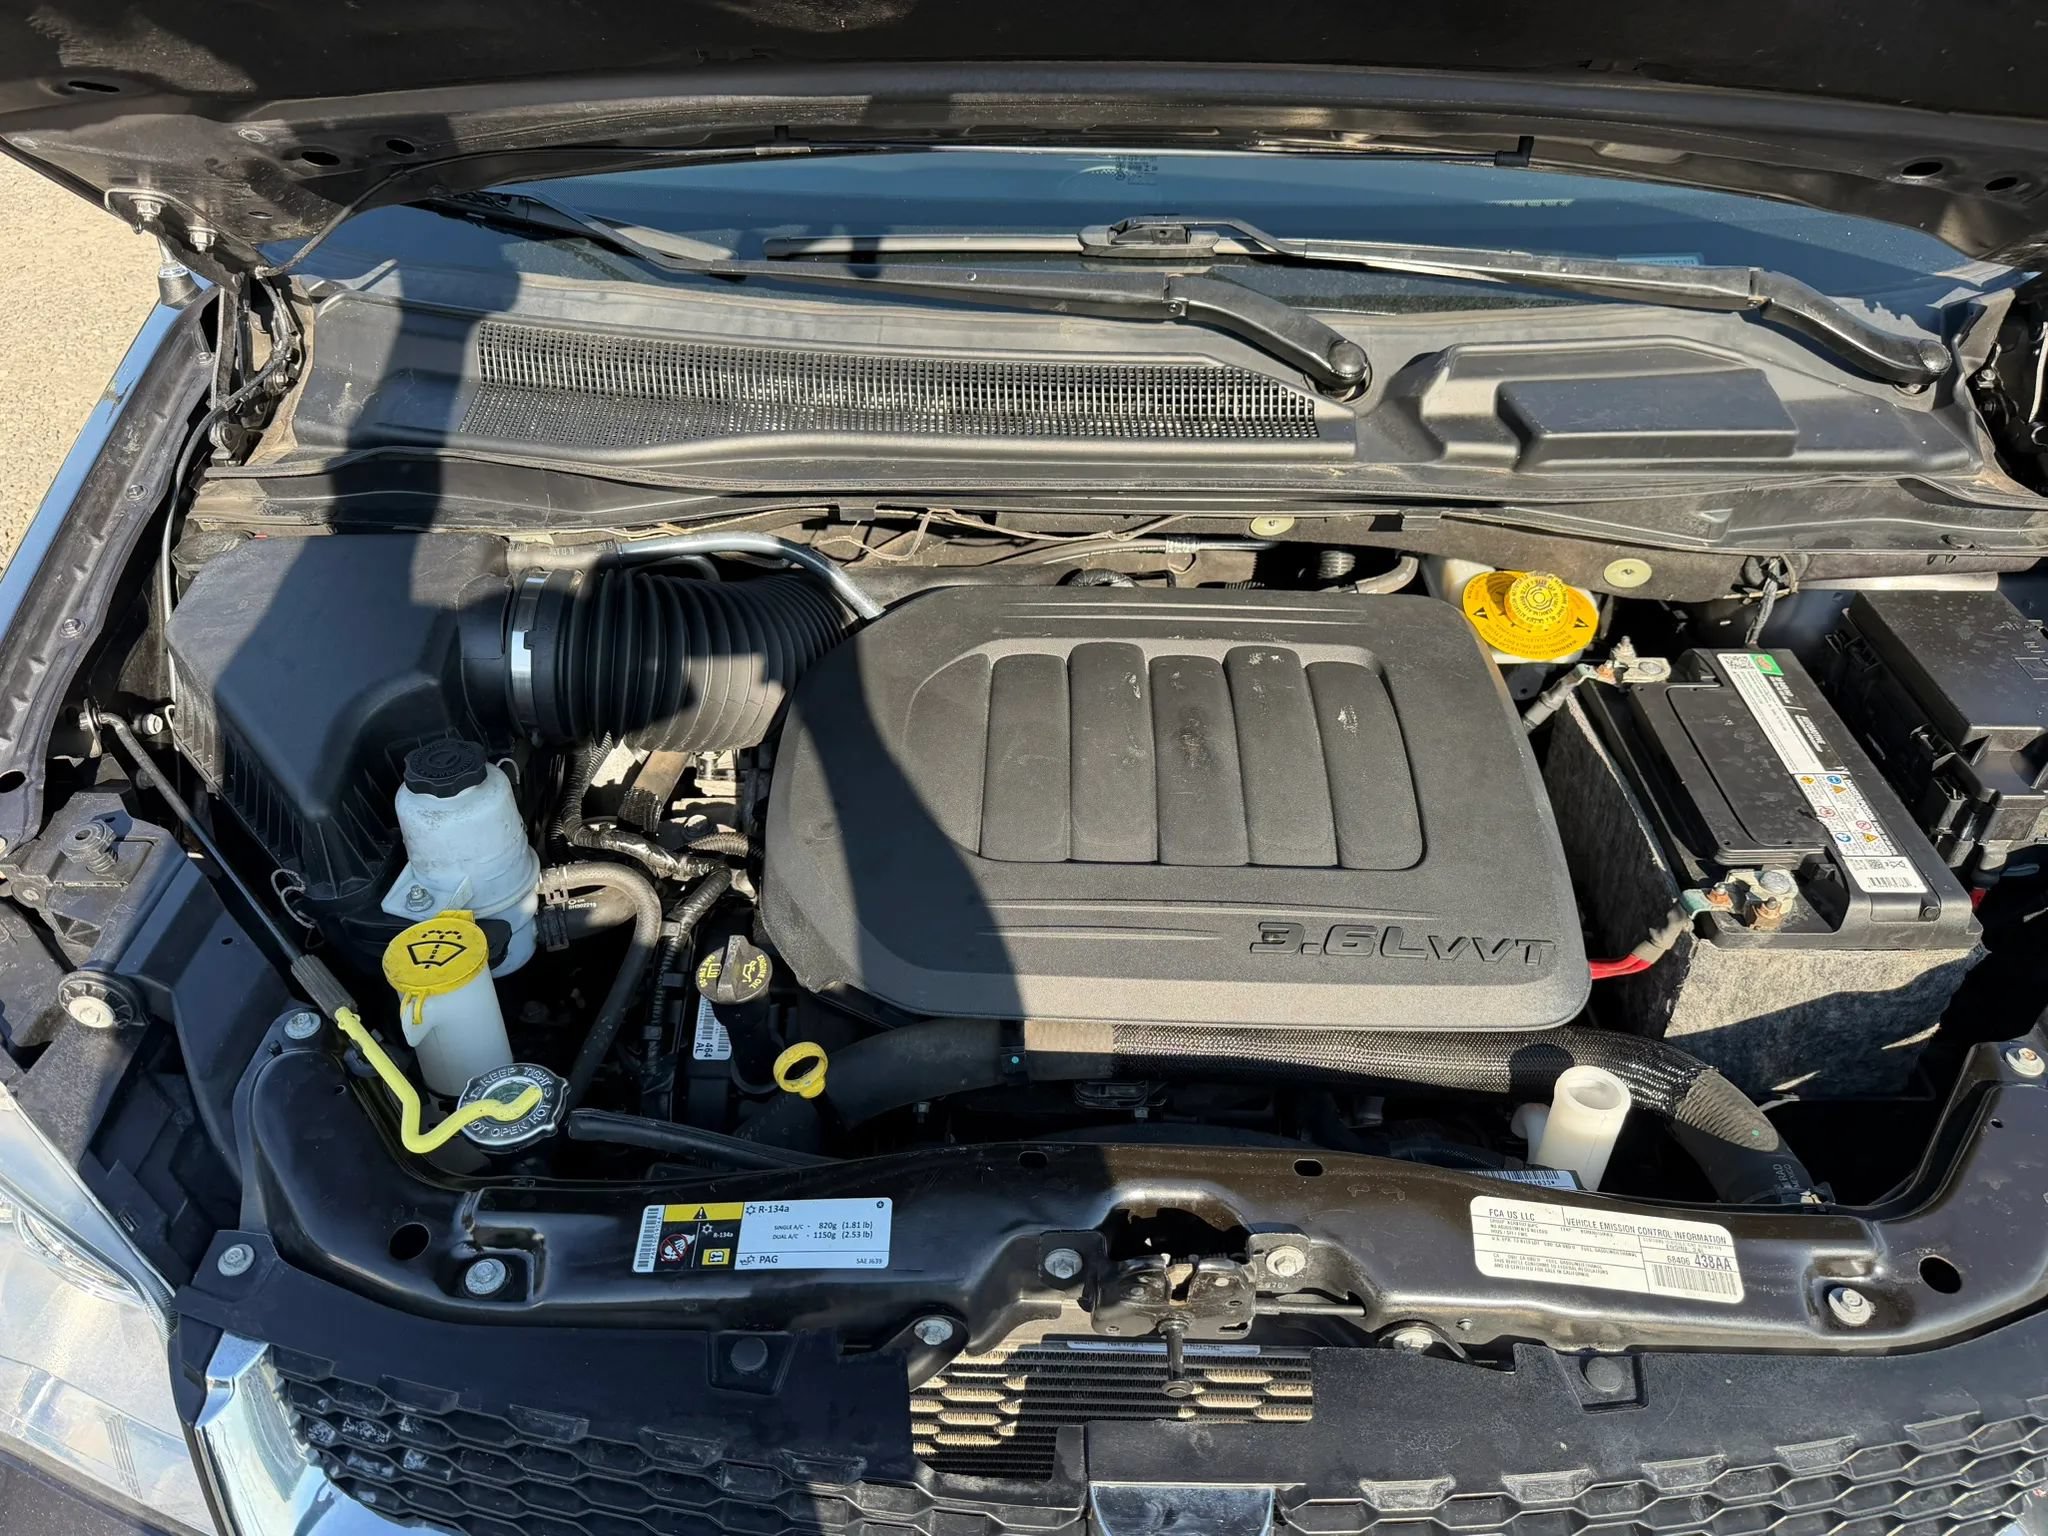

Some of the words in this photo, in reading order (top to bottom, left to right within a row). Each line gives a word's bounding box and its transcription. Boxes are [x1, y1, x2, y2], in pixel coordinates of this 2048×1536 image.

[1250, 921, 1427, 961] 3.6L
[1427, 935, 1557, 966] VVT
[757, 954, 767, 978] ENGINE
[749, 978, 762, 988] OIL
[695, 1042, 704, 1054] AL
[703, 1043, 713, 1058] 464
[480, 1067, 517, 1087] KEEP
[523, 1066, 553, 1087] TIGHT
[491, 1122, 529, 1138] OPEN
[528, 1103, 552, 1124] HOT
[1772, 1163, 1788, 1182] RAD
[758, 1204, 790, 1214] R-134a
[1488, 1208, 1505, 1218] FCA
[1506, 1210, 1518, 1220] US
[1520, 1211, 1535, 1221] LLC
[818, 1222, 837, 1231] 820g
[841, 1221, 861, 1230] (1.81
[862, 1221, 873, 1230] lb)
[1565, 1217, 1598, 1229] VEHICLE
[1599, 1221, 1636, 1234] EMISSION
[1637, 1226, 1671, 1239] CONTROL
[1673, 1231, 1727, 1245] INFORMATION
[813, 1231, 837, 1240] 1150g
[841, 1231, 861, 1240] (2.53
[862, 1231, 873, 1239] lb)
[758, 1255, 779, 1264] PAG
[1666, 1255, 1691, 1266] 68406
[1694, 1254, 1732, 1271] 438AA
